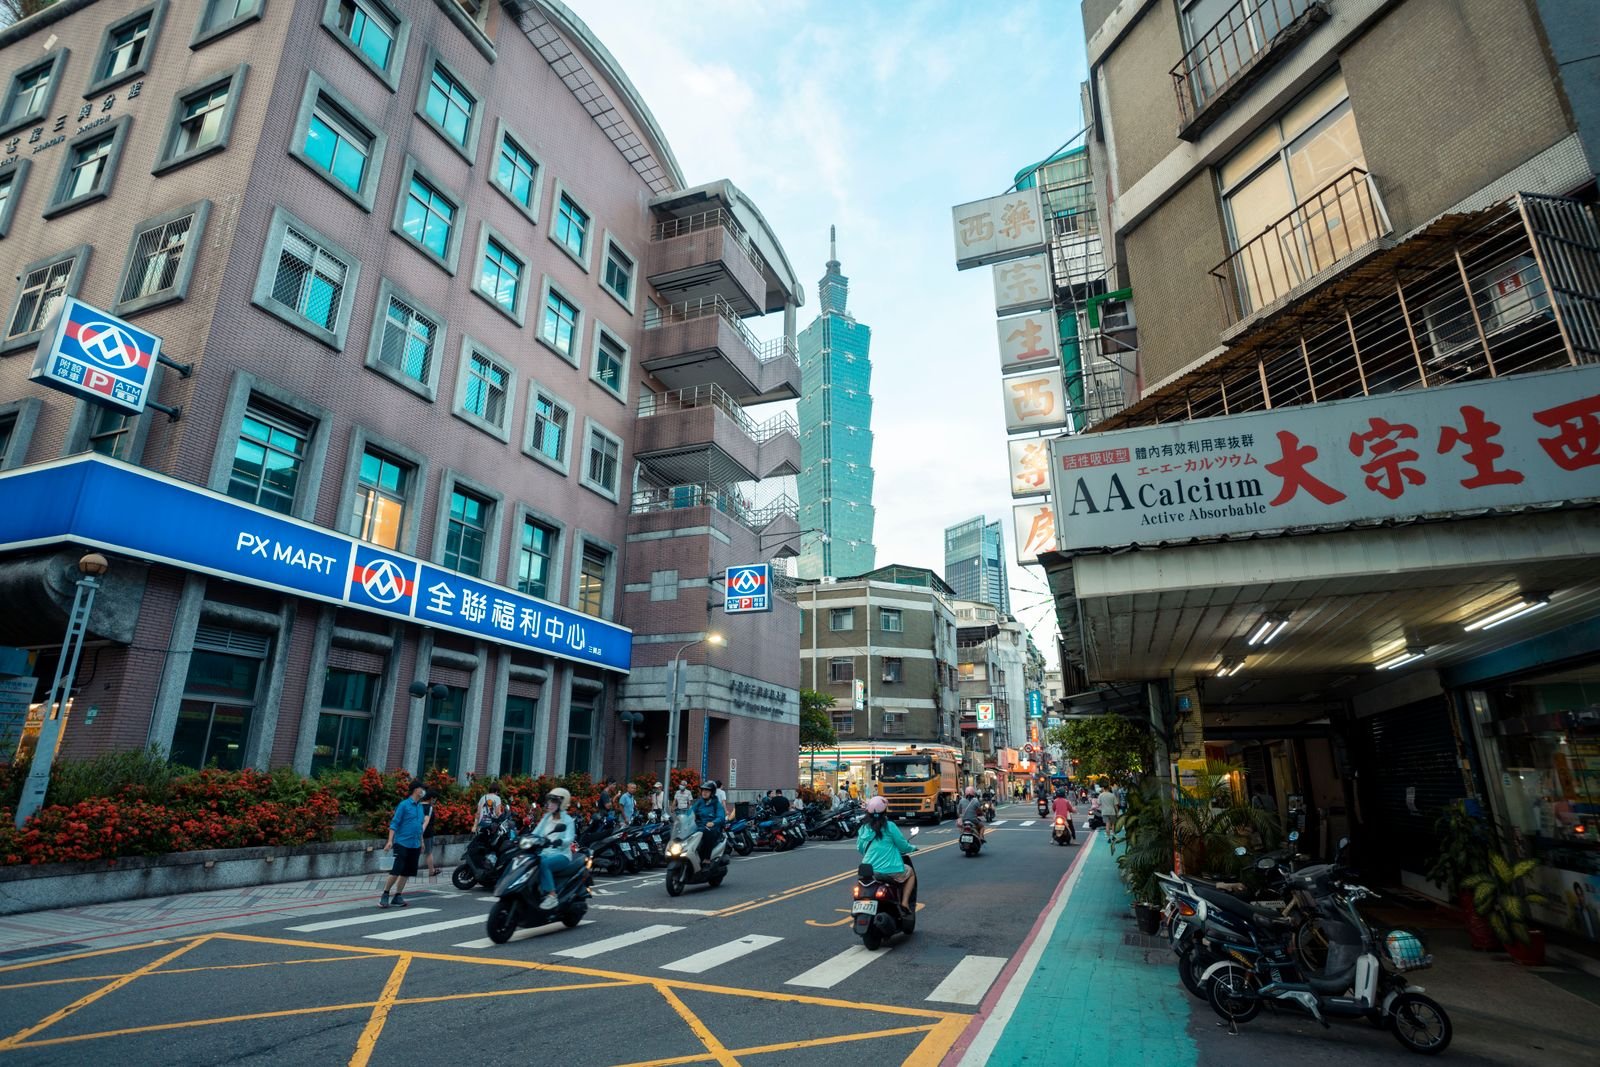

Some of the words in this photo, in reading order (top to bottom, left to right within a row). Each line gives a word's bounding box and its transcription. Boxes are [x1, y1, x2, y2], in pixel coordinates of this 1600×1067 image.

[57, 368, 80, 382] 停車
[60, 358, 83, 374] 附設
[89, 371, 109, 388] P
[115, 382, 141, 396] ATM
[1065, 449, 1128, 470] 活性吸收型
[1264, 394, 1600, 507] 大宗生西
[1138, 476, 1264, 509] Calcium
[1141, 510, 1185, 526] Active
[1188, 501, 1267, 522] Absorbable
[236, 531, 271, 559] PX
[273, 541, 337, 575] MART
[741, 598, 751, 609] P
[426, 581, 586, 650] 全聯福利中心
